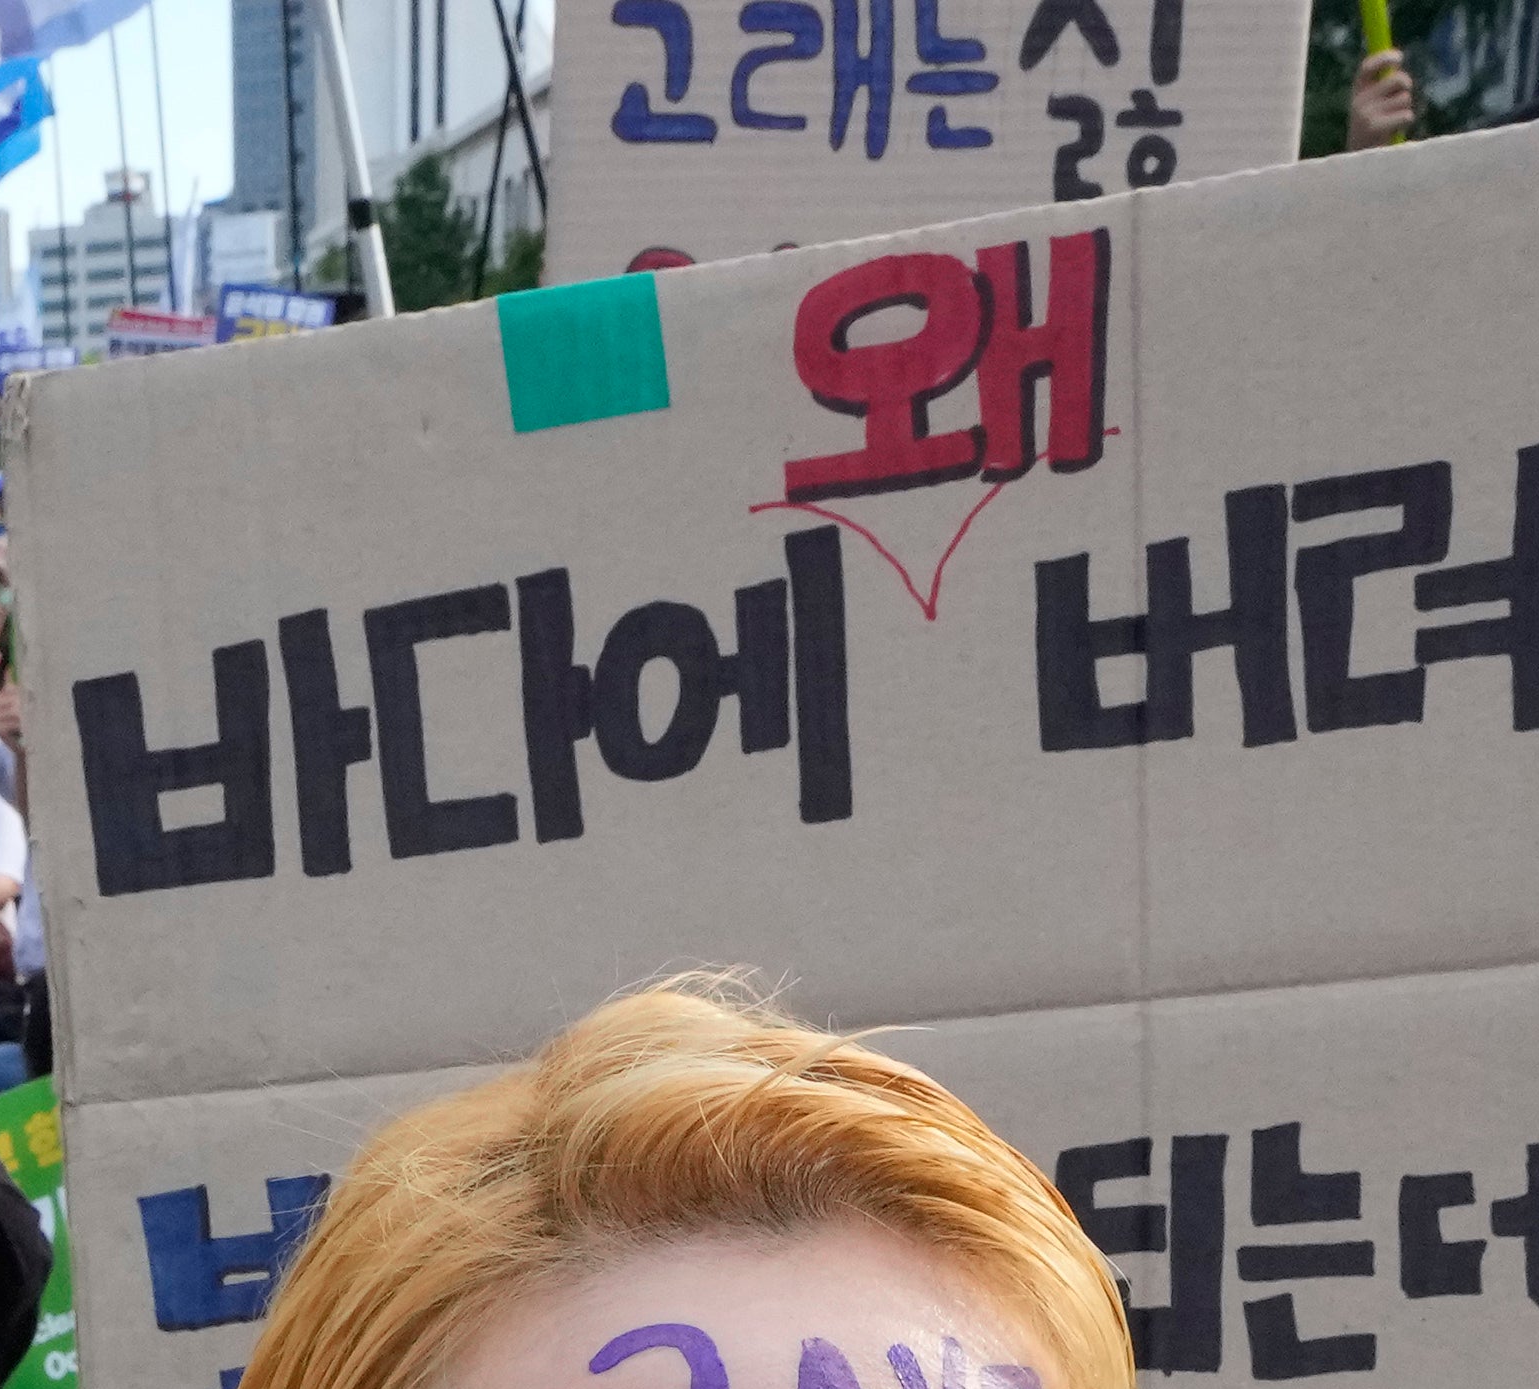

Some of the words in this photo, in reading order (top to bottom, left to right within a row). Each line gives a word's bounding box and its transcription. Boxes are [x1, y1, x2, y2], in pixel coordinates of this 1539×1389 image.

[611, 0, 999, 160] 고래는
[783, 226, 1114, 504] 왜
[70, 526, 855, 898] 바다에
